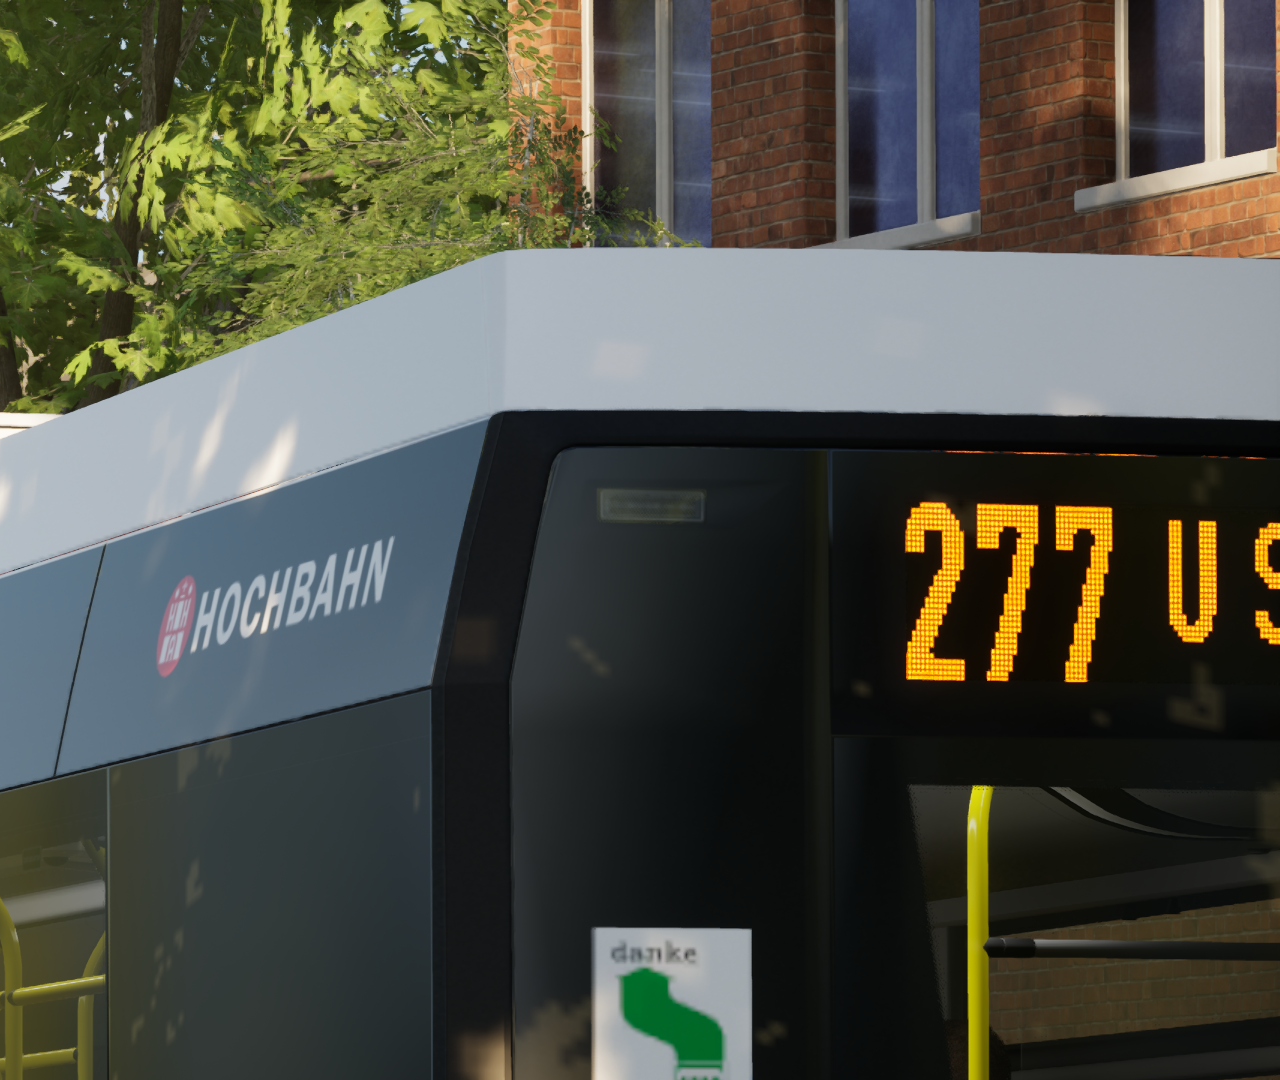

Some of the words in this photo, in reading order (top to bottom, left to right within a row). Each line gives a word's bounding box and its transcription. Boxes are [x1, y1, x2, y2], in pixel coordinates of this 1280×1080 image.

[190, 535, 396, 654] HOCHBAHN
[905, 502, 1113, 682] 277
[1168, 520, 1217, 643] U
[611, 941, 696, 964] danke
